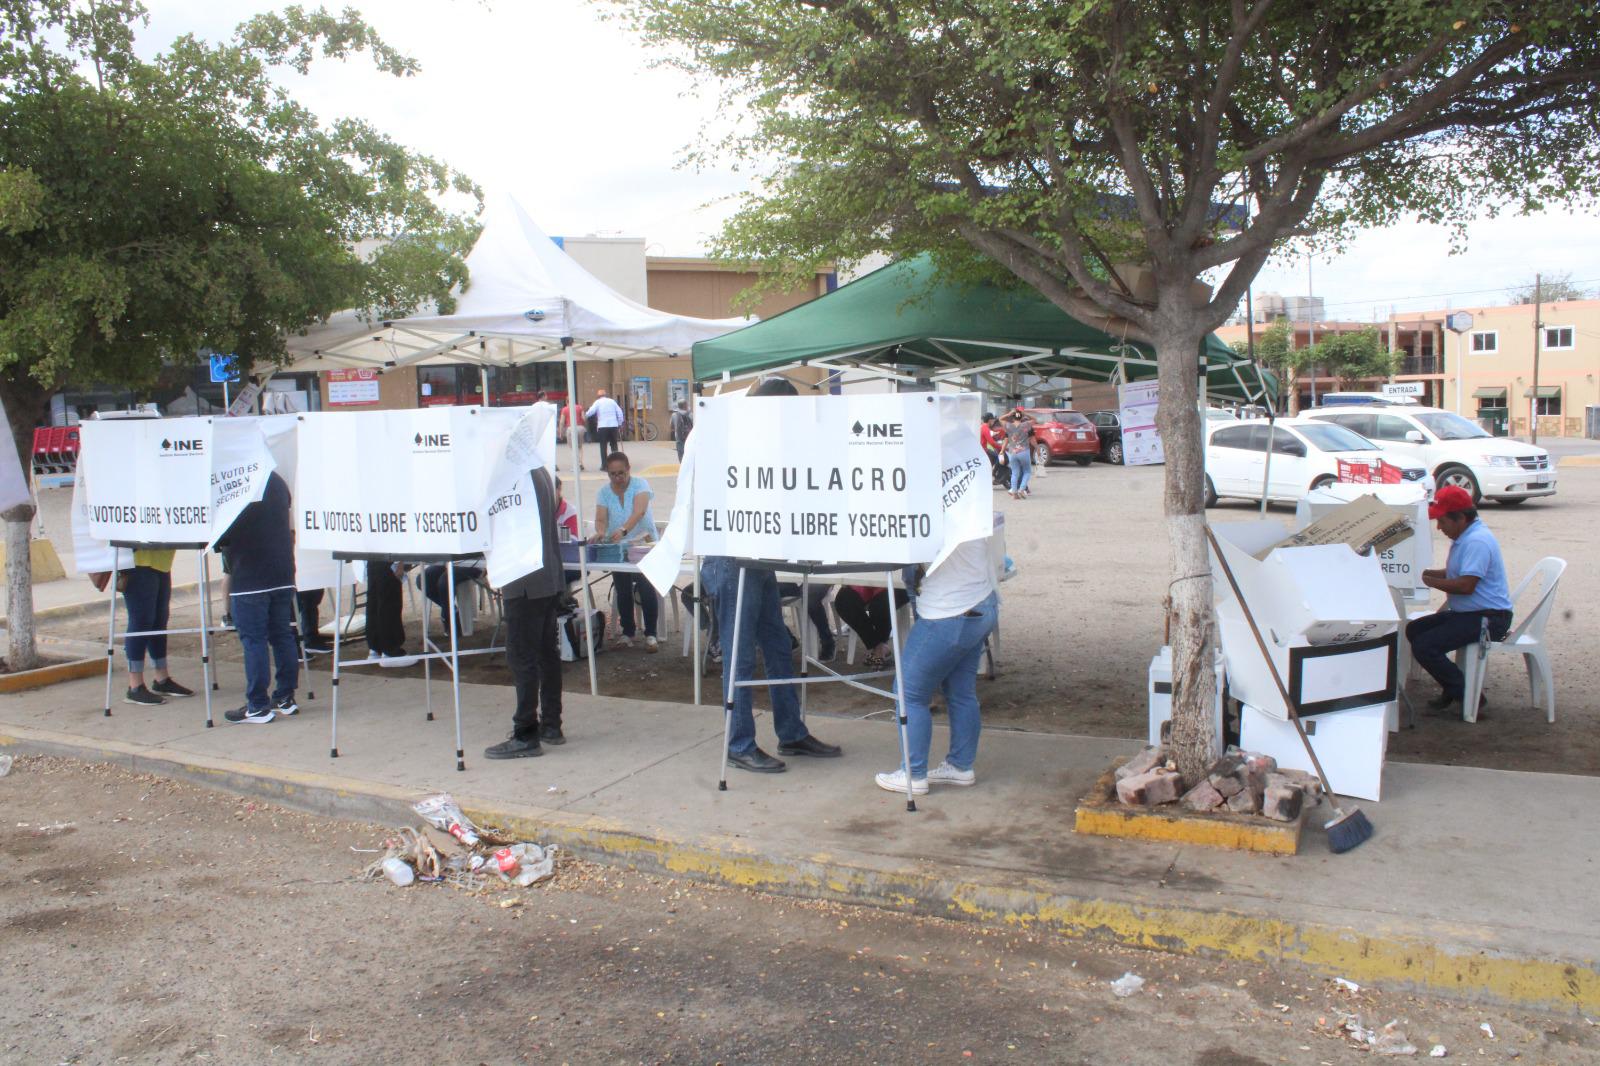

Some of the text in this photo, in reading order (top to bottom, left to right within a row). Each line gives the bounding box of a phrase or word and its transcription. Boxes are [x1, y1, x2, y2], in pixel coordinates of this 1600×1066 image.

[1388, 386, 1417, 394] ENTRADA
[867, 424, 904, 438] INE
[174, 439, 204, 451] INE
[424, 434, 450, 447] INE
[248, 462, 259, 473] ES
[727, 465, 906, 492] SIMULACRO
[942, 470, 976, 512] ECRETO
[140, 506, 162, 524] LIBRE
[305, 510, 320, 530] EL
[369, 512, 407, 533] LIBRE
[704, 508, 722, 532] EL
[790, 512, 838, 536] LIBRE
